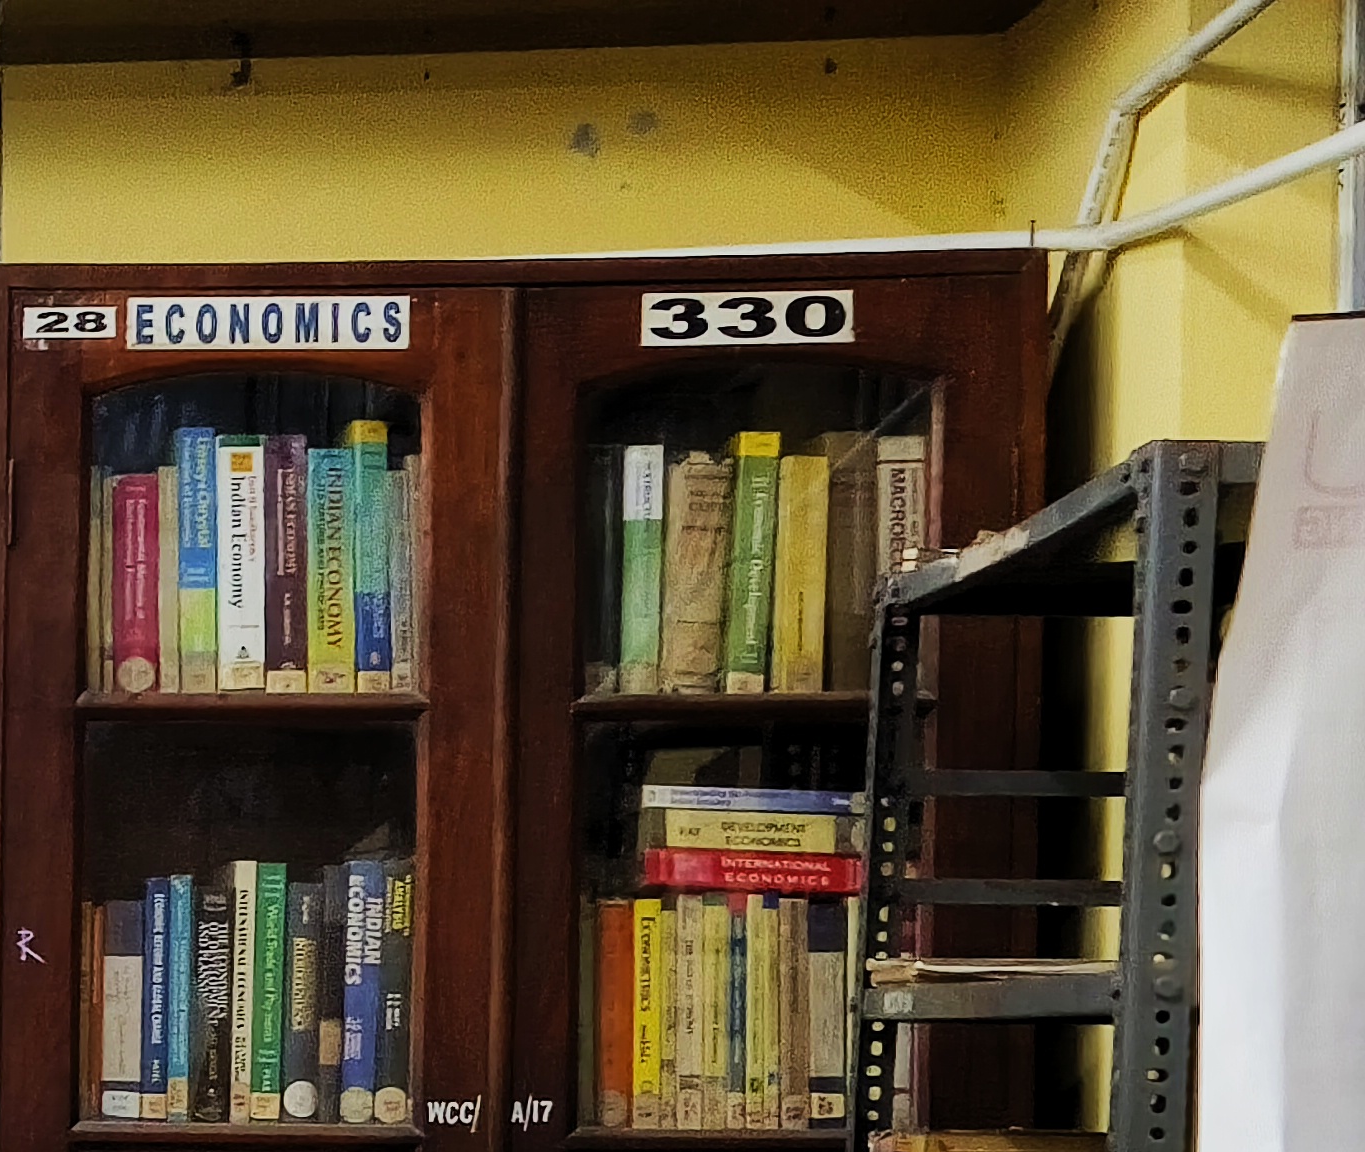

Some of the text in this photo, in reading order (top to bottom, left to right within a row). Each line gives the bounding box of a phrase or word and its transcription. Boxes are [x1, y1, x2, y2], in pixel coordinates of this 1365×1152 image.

[35, 311, 109, 333] 28
[133, 301, 403, 345] ECONOMICS
[649, 295, 847, 340] 330
[229, 475, 247, 610] Indian Economy
[326, 466, 345, 650] INDIAN ECONOMY
[720, 821, 808, 836] DEVELOPMENT
[724, 834, 803, 848] ECONOMICS
[720, 855, 833, 872] INTERNATIONAL
[723, 872, 830, 886] ECONOMICS
[344, 873, 365, 987] ECONOMICS
[363, 895, 384, 966] INDIAN
[427, 1093, 482, 1134] WCC/
[510, 1092, 553, 1132] A/17
